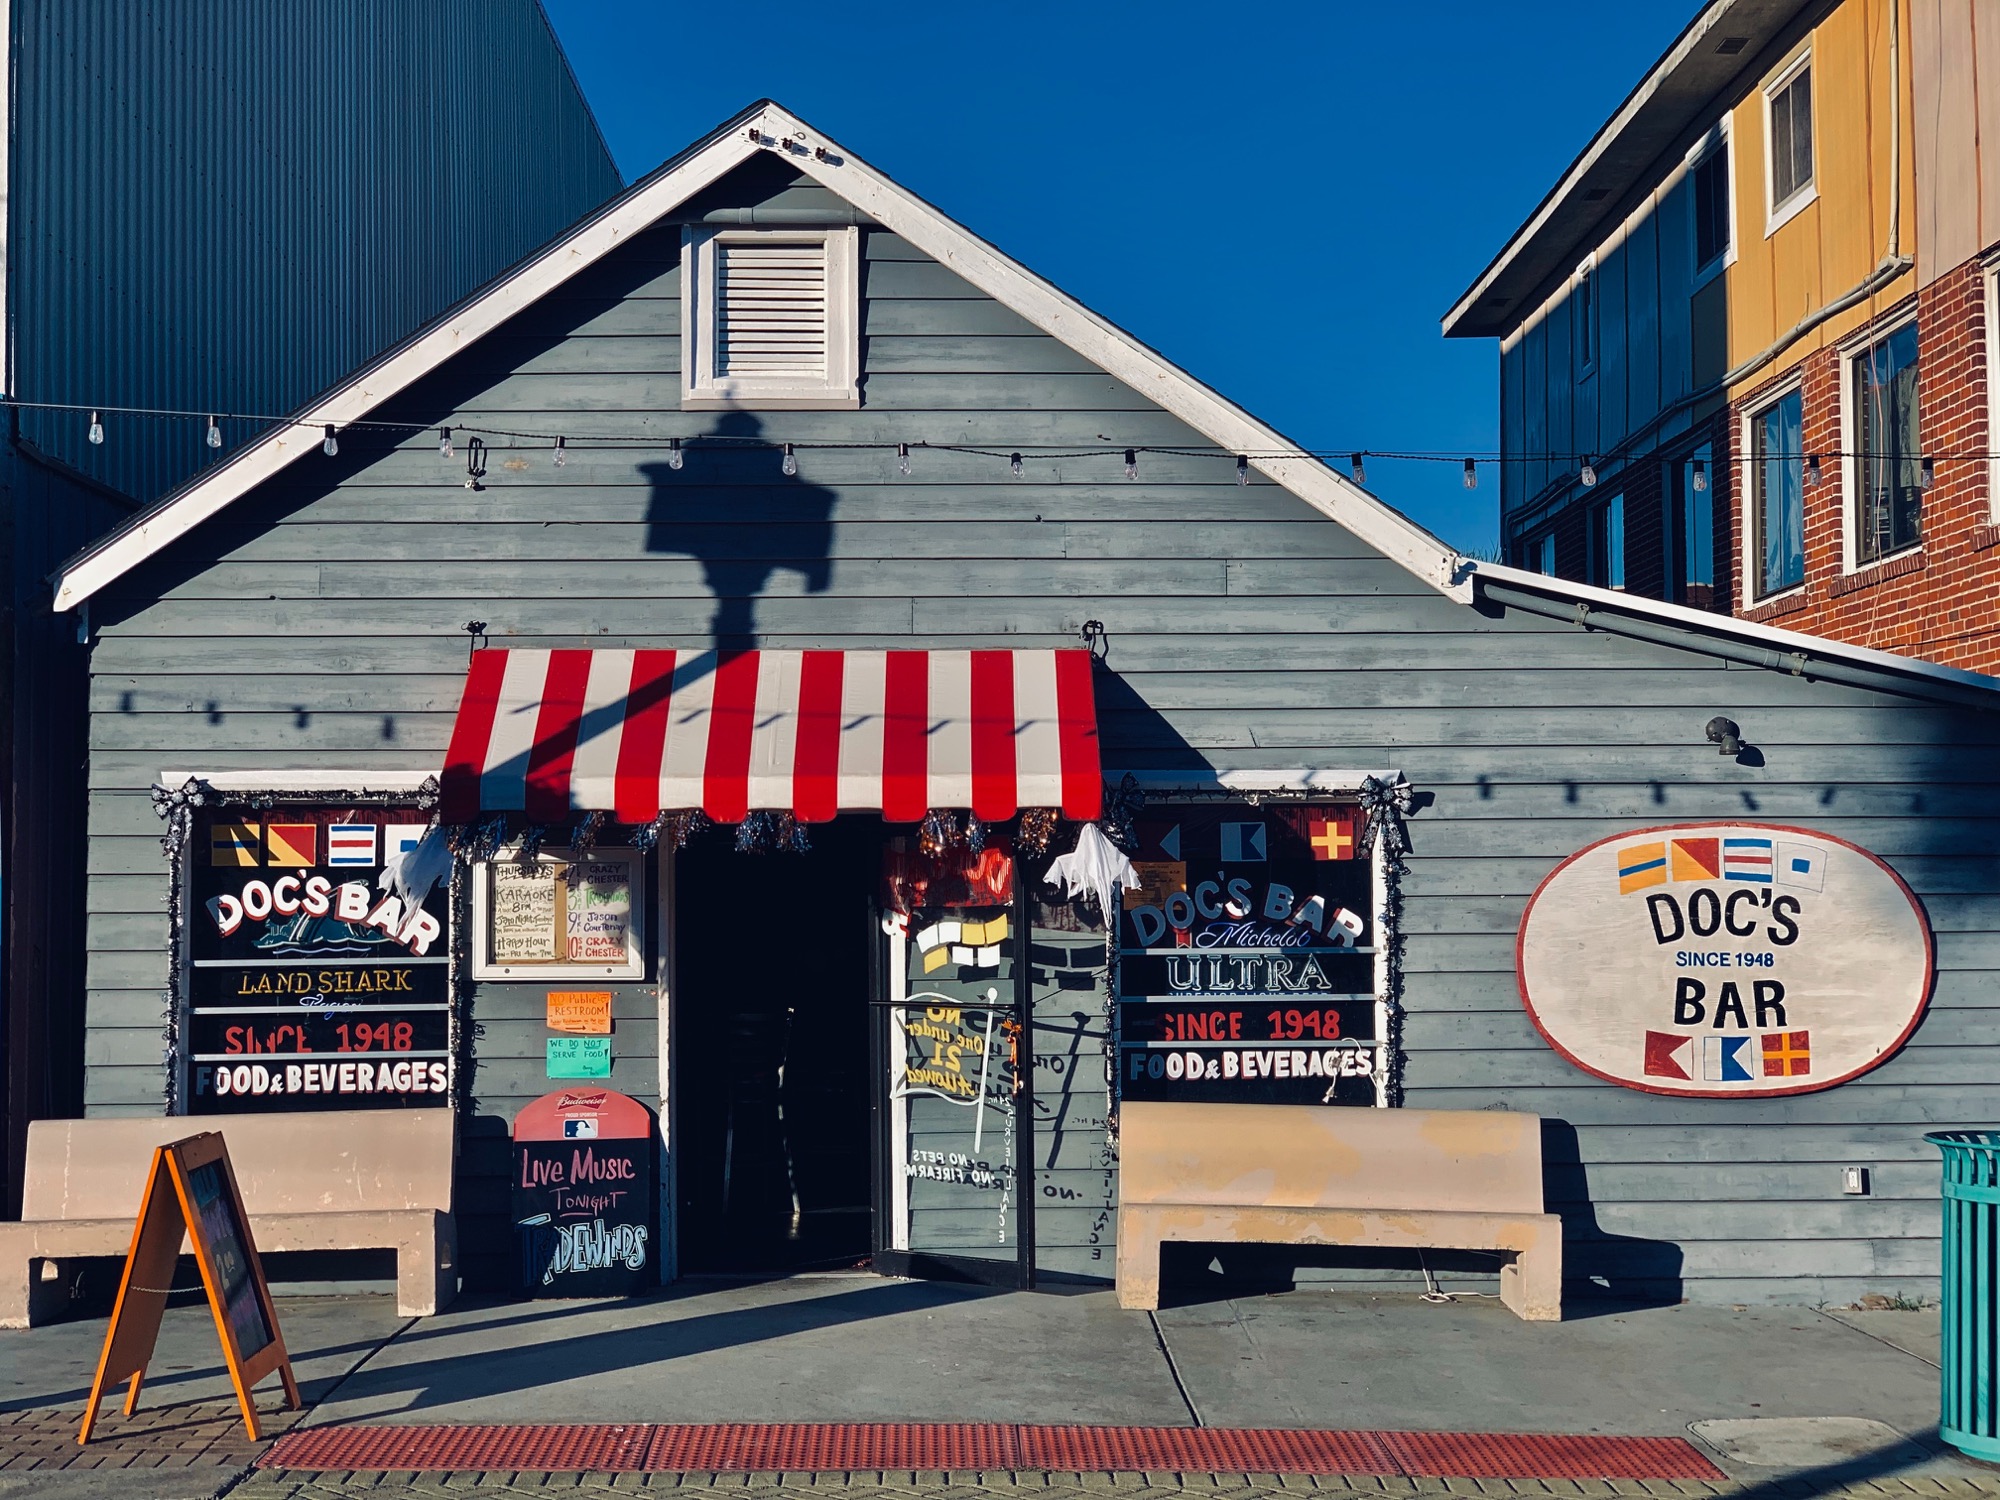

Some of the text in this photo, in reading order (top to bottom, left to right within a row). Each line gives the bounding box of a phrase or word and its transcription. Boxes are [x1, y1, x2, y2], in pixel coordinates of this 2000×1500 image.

[497, 865, 554, 876] THURSDAYS
[588, 875, 628, 884] CHESTER
[590, 866, 621, 874] CRAZY
[496, 888, 554, 902] KARAOKE
[206, 869, 440, 956] DOC'S BAR
[1130, 871, 1252, 948] DOC'S
[1262, 882, 1364, 948] BAR
[1646, 888, 1801, 946] DOC'S
[568, 912, 578, 934] 9
[588, 912, 618, 922] Jason
[495, 937, 550, 950] Happy Hour
[1196, 921, 1312, 948] Michelob
[568, 936, 578, 958] 10
[586, 936, 623, 946] CRAZY
[586, 948, 624, 958] CHESTER
[1676, 951, 1774, 968] SINCE 1948
[318, 970, 414, 993] SHARK
[1166, 953, 1332, 990] ULTRA
[569, 994, 597, 1004] Public
[1674, 977, 1788, 1029] BAR
[1160, 1009, 1340, 1041] SINCE 1948
[336, 1022, 414, 1052] 1948
[550, 1040, 603, 1048] WE DO NOT
[557, 1096, 608, 1106] Budweiser
[513, 1213, 648, 1287] TRADEWINDS
